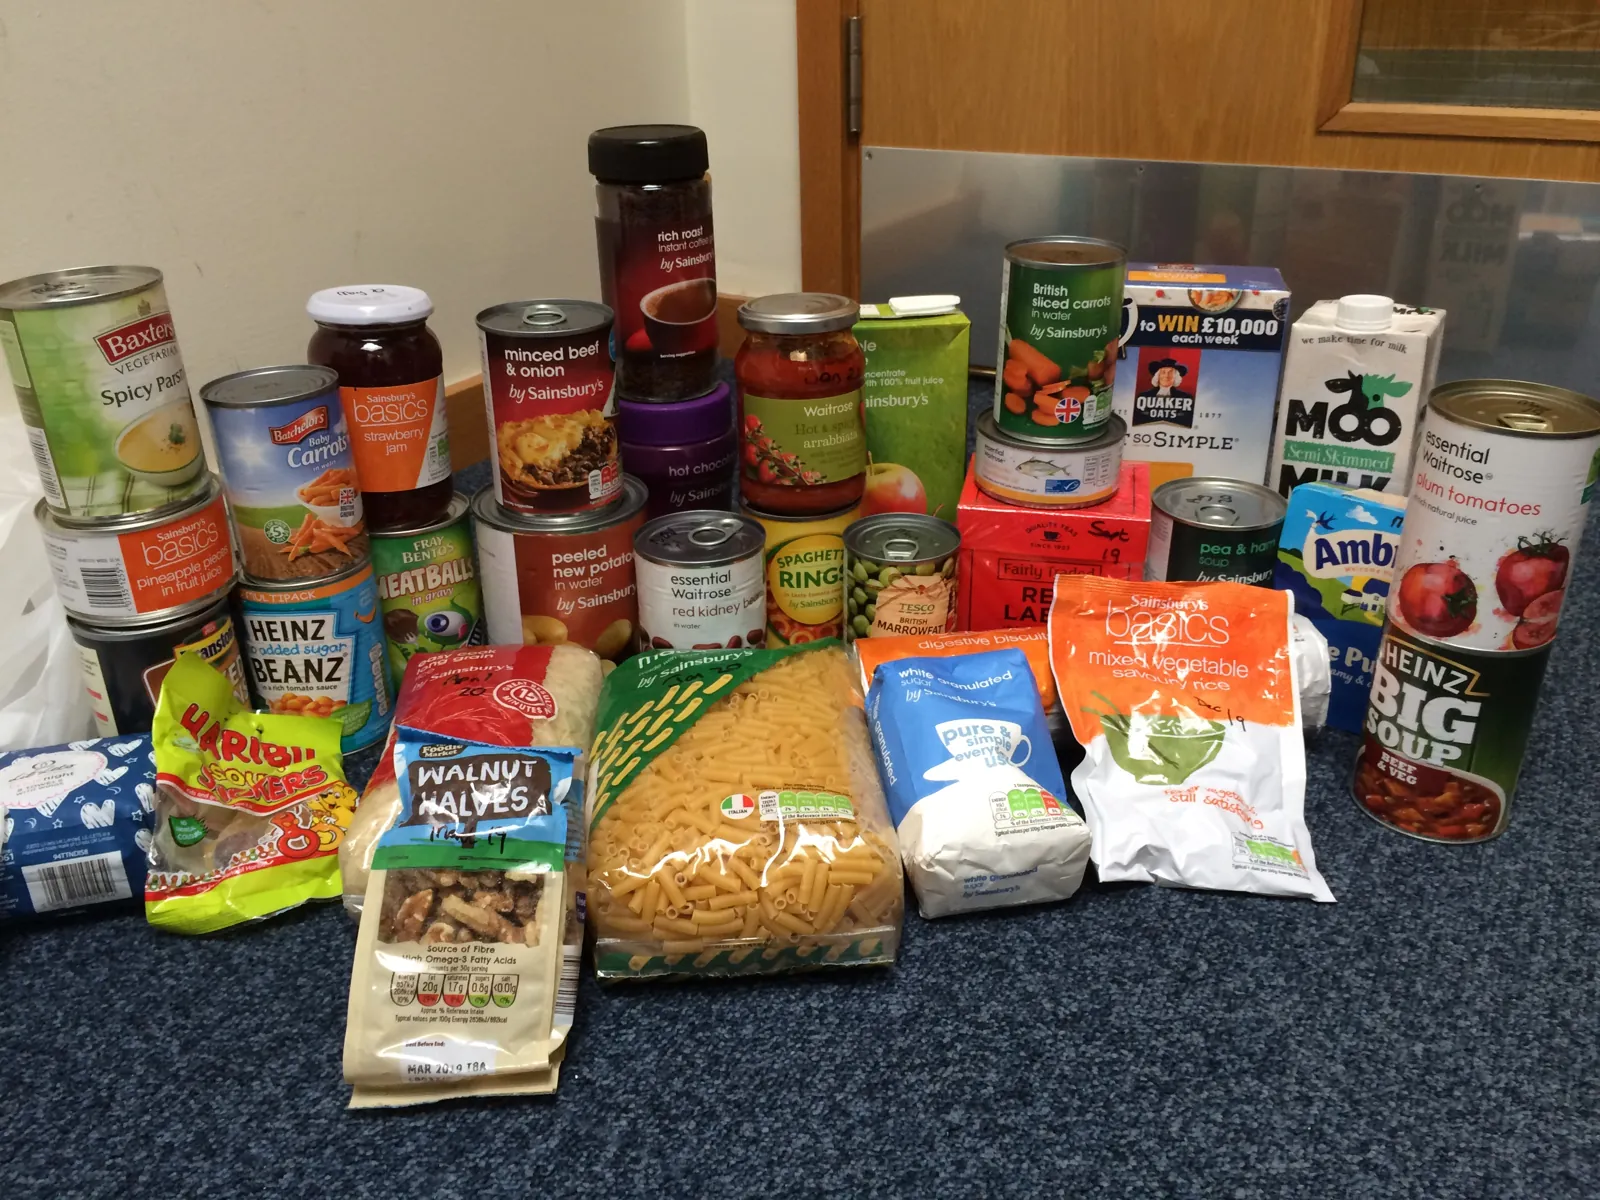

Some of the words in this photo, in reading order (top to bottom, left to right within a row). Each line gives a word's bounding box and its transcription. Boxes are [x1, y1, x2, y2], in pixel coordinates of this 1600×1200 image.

[658, 231, 679, 242] rich
[682, 226, 703, 240] roast
[658, 241, 687, 253] instant
[660, 258, 674, 273] by
[1033, 283, 1068, 297] British
[1032, 297, 1069, 309] sliced
[1072, 297, 1111, 310] carrots
[1031, 309, 1040, 318] in
[1043, 310, 1072, 321] water
[1030, 326, 1045, 340] by
[1046, 324, 1108, 339] Sainsbury's
[1140, 319, 1156, 332] to
[1157, 314, 1199, 333] WIN
[1201, 317, 1278, 336] £10,000
[105, 323, 175, 357] Baxters
[1171, 333, 1202, 344] each
[1204, 334, 1239, 345] week
[1301, 336, 1315, 344] we
[1318, 335, 1343, 344] make
[1347, 335, 1367, 345] time
[1370, 337, 1386, 348] for
[1388, 342, 1407, 354] milk
[504, 347, 564, 362] minced
[568, 341, 600, 358] beef
[506, 363, 516, 376] &
[520, 365, 565, 377] onion
[879, 378, 902, 386] 100%
[905, 377, 921, 385] fruit
[923, 376, 944, 385] juice
[101, 383, 153, 408] Spicy
[366, 392, 416, 404] Sainsbury's
[509, 384, 526, 404] by
[528, 379, 604, 400] Sainsbury's
[353, 399, 428, 423] basics
[803, 401, 854, 418] Waitrose
[1136, 396, 1193, 412] QUAKER
[1149, 409, 1177, 419] OATS
[1285, 398, 1402, 446] MOO
[274, 412, 325, 442] Batchelors
[364, 428, 424, 441] strawberry
[794, 423, 818, 436] Hot
[309, 434, 330, 447] Baby
[803, 431, 858, 449] arrabbiata
[1425, 430, 1490, 464] essential
[287, 435, 347, 468] Carrots
[385, 441, 408, 456] jam
[1287, 443, 1320, 460] Semi
[1325, 449, 1389, 470] Skimmed
[669, 464, 689, 476] hot
[1422, 449, 1484, 484] Waitrose
[670, 491, 685, 507] by
[1416, 473, 1444, 498] plum
[1448, 486, 1542, 516] tomatoes
[1427, 504, 1455, 519] natural
[1455, 516, 1478, 526] juice
[157, 518, 206, 542] Sainsbury's
[1026, 522, 1058, 534] QUALITY
[141, 522, 218, 567] basics
[413, 536, 444, 551] FRAY
[1200, 543, 1231, 555] pea
[1236, 543, 1246, 555] &
[402, 542, 454, 564] BENTOS
[552, 545, 607, 566] peeled
[1102, 548, 1121, 564] 19
[137, 561, 201, 590] pineapple
[203, 545, 229, 571] pieces
[1199, 556, 1229, 567] soup
[553, 566, 585, 578] new
[670, 570, 731, 586] essential
[1004, 563, 1042, 580] Fairly
[162, 586, 174, 597] in
[176, 577, 198, 592] fruit
[200, 565, 222, 588] juice
[554, 580, 566, 590] in
[569, 576, 603, 589] water
[412, 594, 422, 606] in
[425, 587, 454, 606] gravy
[671, 587, 731, 600] Waitrose
[557, 598, 576, 615] by
[672, 605, 695, 617] red
[697, 602, 741, 617] kidney
[788, 600, 799, 610] by
[901, 603, 935, 612] TESCO
[1131, 594, 1209, 611] Sainsbury's
[877, 620, 944, 635] MARROWFAT
[899, 616, 928, 625] BRITISH
[1106, 600, 1230, 645] basics
[250, 619, 326, 642] HEINZ
[259, 644, 300, 656] added
[304, 643, 347, 656] sugar
[918, 636, 990, 650] digestive
[418, 653, 450, 668] easy
[457, 649, 496, 658] cook
[453, 653, 494, 663] grain
[1089, 650, 1148, 668] mixed
[1153, 656, 1249, 680] vegetable
[251, 657, 344, 684] BEANZ
[898, 667, 934, 680] white
[1386, 643, 1468, 694] HEINZ
[637, 675, 658, 689] by
[900, 678, 932, 688] sugar
[1112, 668, 1186, 691] savoury
[1193, 679, 1231, 691] rice
[459, 687, 486, 696] 20
[519, 688, 539, 702] 15
[905, 689, 923, 703] by
[502, 694, 543, 714] MINUTES
[1370, 662, 1482, 744] BIG
[942, 724, 995, 747] pure
[1000, 726, 1011, 739] &
[966, 734, 1012, 752] simple
[1366, 707, 1462, 768] SOUP
[424, 750, 458, 758] Market
[1381, 751, 1417, 773] BEEF
[418, 759, 537, 787] WALNUT
[1377, 761, 1387, 771] &
[1389, 765, 1417, 785] VEG
[419, 786, 529, 817] HALVES
[1169, 794, 1196, 804] still
[963, 873, 988, 884] white
[963, 881, 984, 890] sugar
[427, 945, 457, 953] Source
[461, 945, 469, 953] of
[473, 945, 496, 954] Fibre
[425, 955, 467, 967] Omega-3
[469, 955, 491, 966] Fatty
[493, 955, 517, 965] Acids
[460, 965, 470, 973] 30g
[422, 982, 438, 993] 20g
[471, 982, 488, 994] 0.8g
[407, 1064, 431, 1075] MAR
